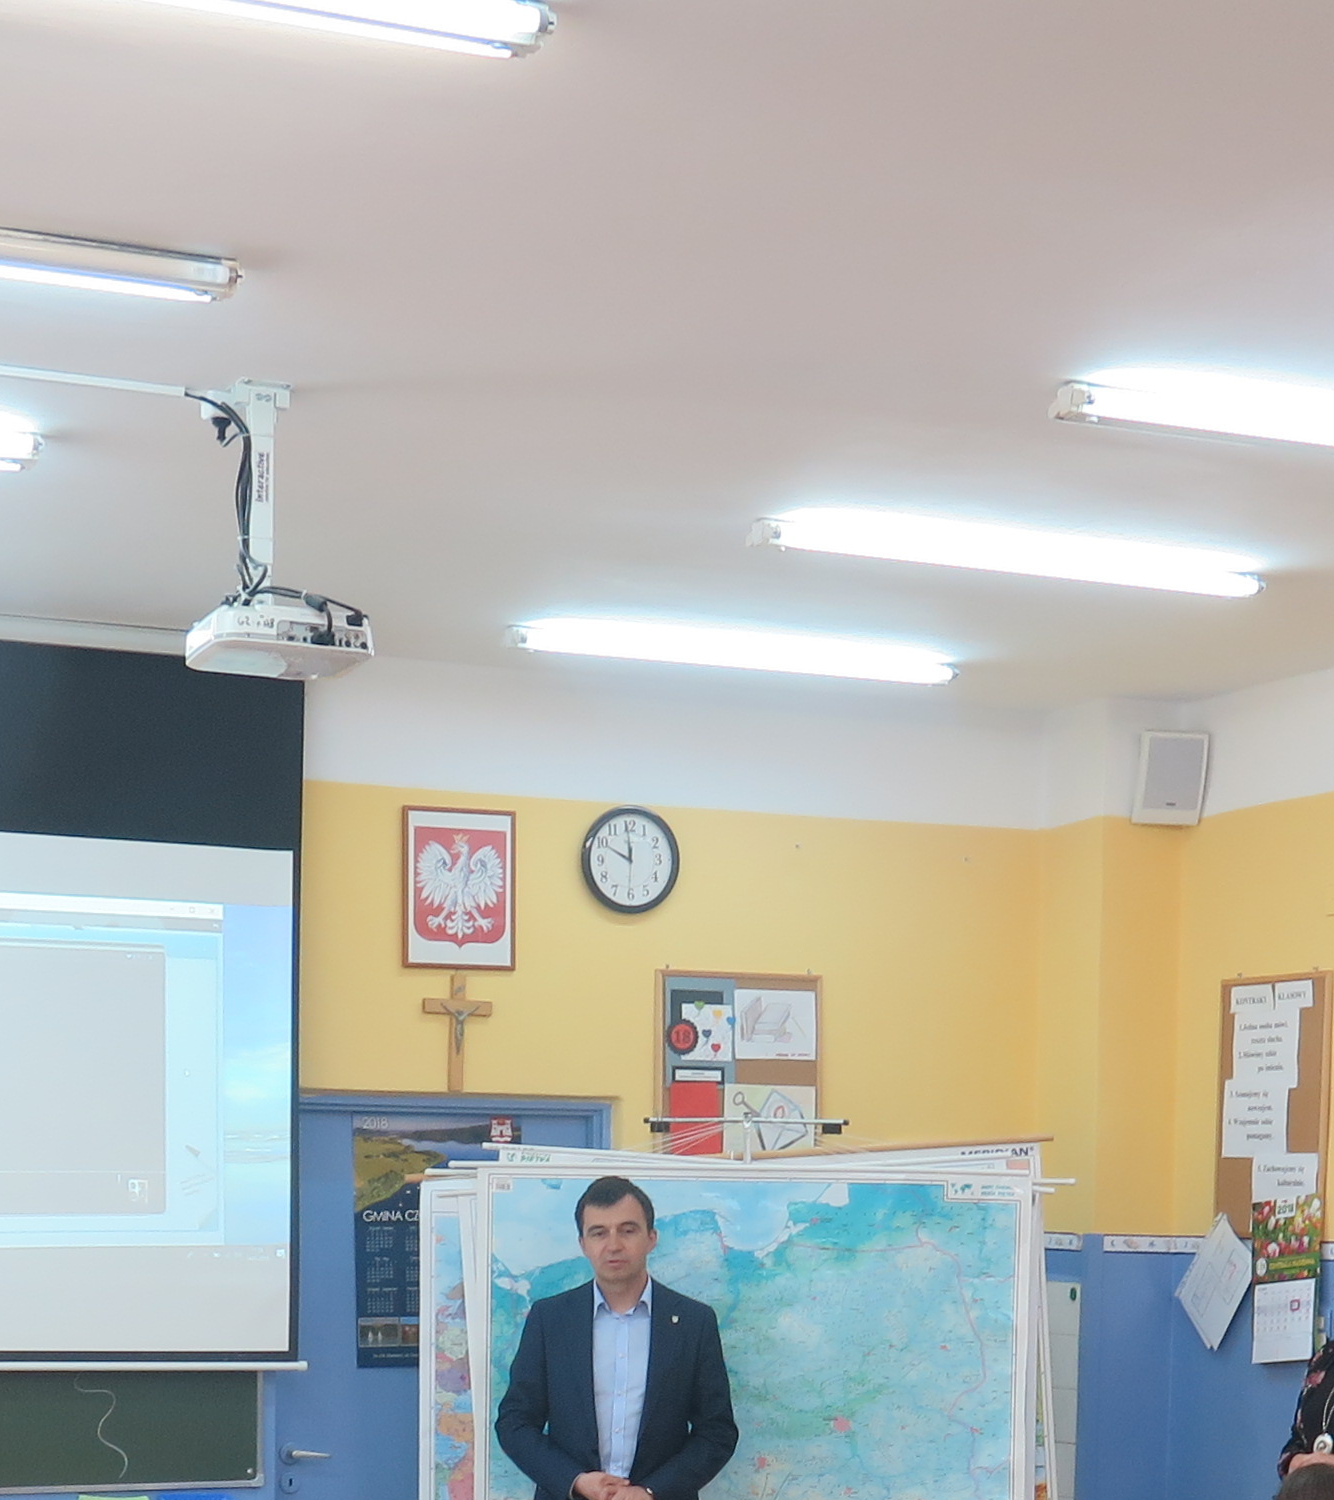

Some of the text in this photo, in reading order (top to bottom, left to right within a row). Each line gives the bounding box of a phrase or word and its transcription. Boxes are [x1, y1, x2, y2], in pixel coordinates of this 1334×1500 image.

[608, 823, 618, 836] 11
[624, 820, 636, 832] 12
[642, 824, 647, 837] 1
[597, 836, 608, 849] 10
[651, 837, 659, 849] 2
[597, 854, 604, 866] 9
[654, 853, 662, 866] 3
[600, 871, 608, 883] 8
[651, 870, 659, 883] 4
[611, 884, 618, 897] 7
[627, 888, 635, 900] 6
[642, 884, 650, 897] 5
[675, 1028, 692, 1044] 18
[363, 1117, 389, 1129] 2018
[362, 1210, 403, 1223] GMINA
